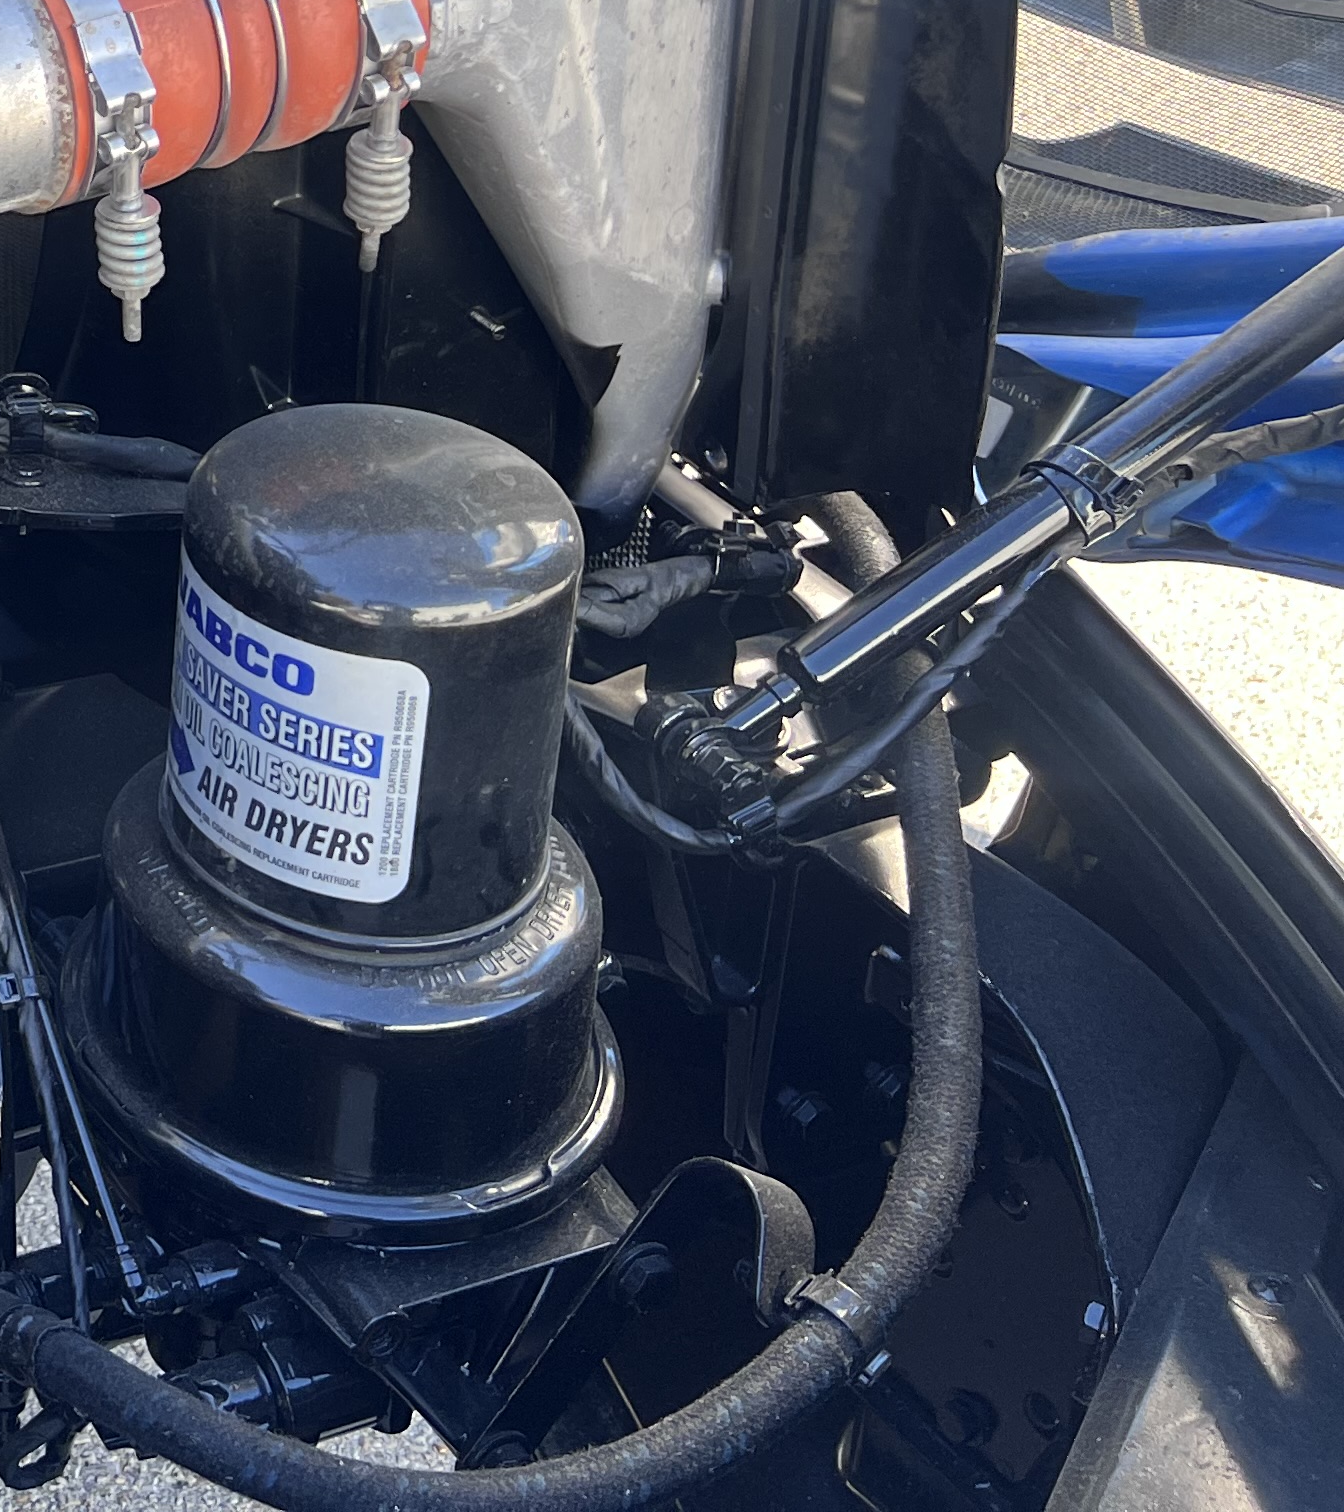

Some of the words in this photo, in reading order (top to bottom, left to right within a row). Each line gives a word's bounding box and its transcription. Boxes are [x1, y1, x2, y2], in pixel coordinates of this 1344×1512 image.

[186, 641, 252, 730] SAVER
[257, 701, 376, 771] SERIES
[392, 734, 402, 746] PN
[404, 734, 413, 746] PN
[209, 718, 370, 818] COALESCING
[387, 748, 400, 794] CARTRIDGE
[398, 748, 412, 795] CARTRIDGE
[197, 765, 238, 819] AIR
[244, 797, 374, 866] DRYERS
[380, 796, 394, 855] REPLACEMENT
[392, 797, 406, 855] REPLACEMENT
[253, 847, 311, 877] REPLACEMENT
[311, 870, 361, 889] CARTRIDGE
[378, 856, 389, 876] 1200
[477, 930, 540, 977] OPEN
[528, 881, 575, 941] DRYER
